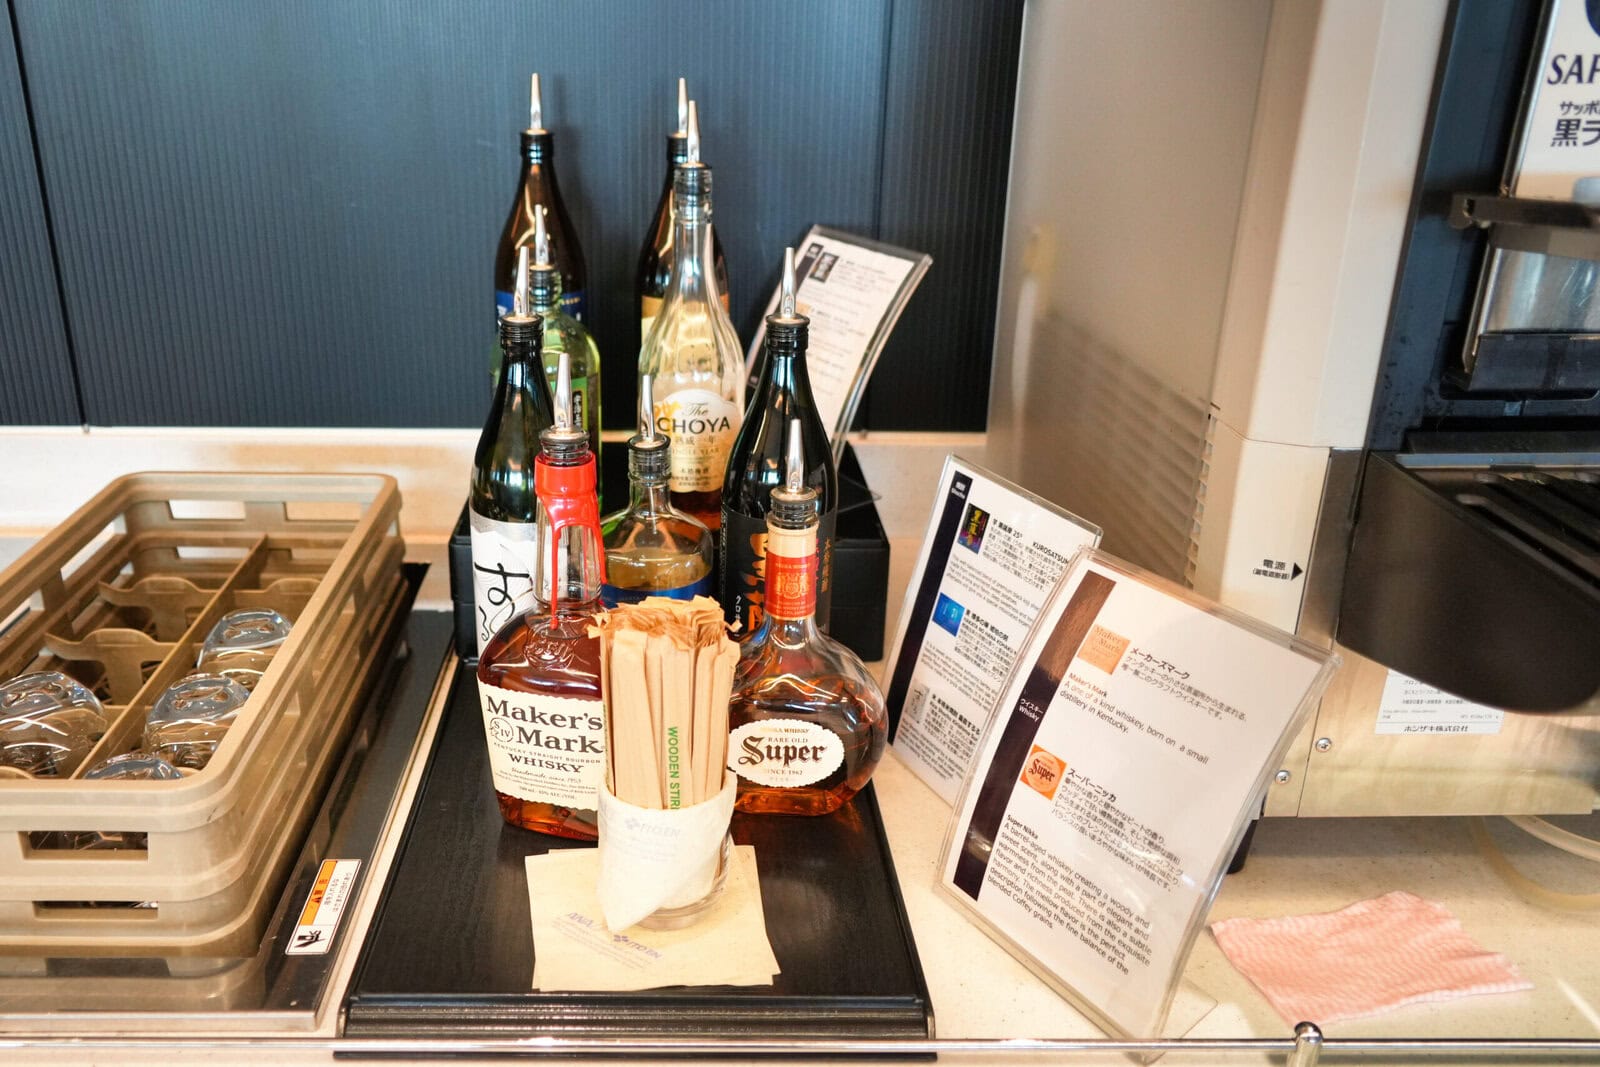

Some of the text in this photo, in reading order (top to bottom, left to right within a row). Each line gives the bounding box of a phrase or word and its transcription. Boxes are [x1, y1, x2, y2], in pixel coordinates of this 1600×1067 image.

[657, 416, 730, 434] CHOYA
[686, 402, 708, 416] The
[1131, 648, 1190, 679] メーカーズマーク
[1092, 685, 1107, 698] Mark
[486, 695, 603, 730] Maker's
[1019, 705, 1040, 722] Whisky
[1060, 690, 1088, 711] distillery
[1096, 709, 1129, 733] Kentucky.
[516, 726, 603, 753] Mark
[1099, 699, 1116, 713] kind
[1115, 709, 1144, 731] whiskey,
[1146, 725, 1165, 740] born
[1186, 749, 1209, 765] small
[508, 753, 584, 773] WHISKY
[668, 727, 681, 810] WOODEN STIR
[738, 735, 827, 768] Super
[1028, 758, 1055, 782] Super
[1068, 768, 1116, 802] スーパーニッカ
[1007, 814, 1038, 840] Super Nikka
[988, 875, 1012, 897] blended
[1012, 893, 1032, 913] Coffey
[999, 842, 1029, 866] warmness
[1030, 862, 1046, 878] from
[1047, 875, 1058, 887] the
[1079, 896, 1098, 916] There
[1106, 919, 1121, 933] also
[1002, 832, 1020, 848] sweet
[1040, 860, 1059, 877] along
[1060, 873, 1075, 887] with
[1081, 889, 1096, 903] part
[1106, 907, 1133, 930] elegant
[1134, 927, 1150, 941] and
[1010, 826, 1047, 856] barrel-aged
[1047, 853, 1073, 875] whiskey
[1074, 872, 1102, 897] creating
[1110, 897, 1134, 918] woody
[1134, 915, 1150, 929] and
[991, 867, 1023, 894] description
[1024, 890, 1052, 918] following
[1053, 913, 1065, 926] the
[1065, 922, 1079, 937] fine
[1079, 933, 1106, 958] balance
[1116, 961, 1129, 975] the
[996, 849, 1150, 967] flavor and richness produced from the exquisite
[1023, 878, 1034, 892] The
[1035, 890, 1059, 910] mellow
[1060, 906, 1079, 924] flavor
[1087, 927, 1099, 941] the
[1100, 938, 1126, 961] perfect
